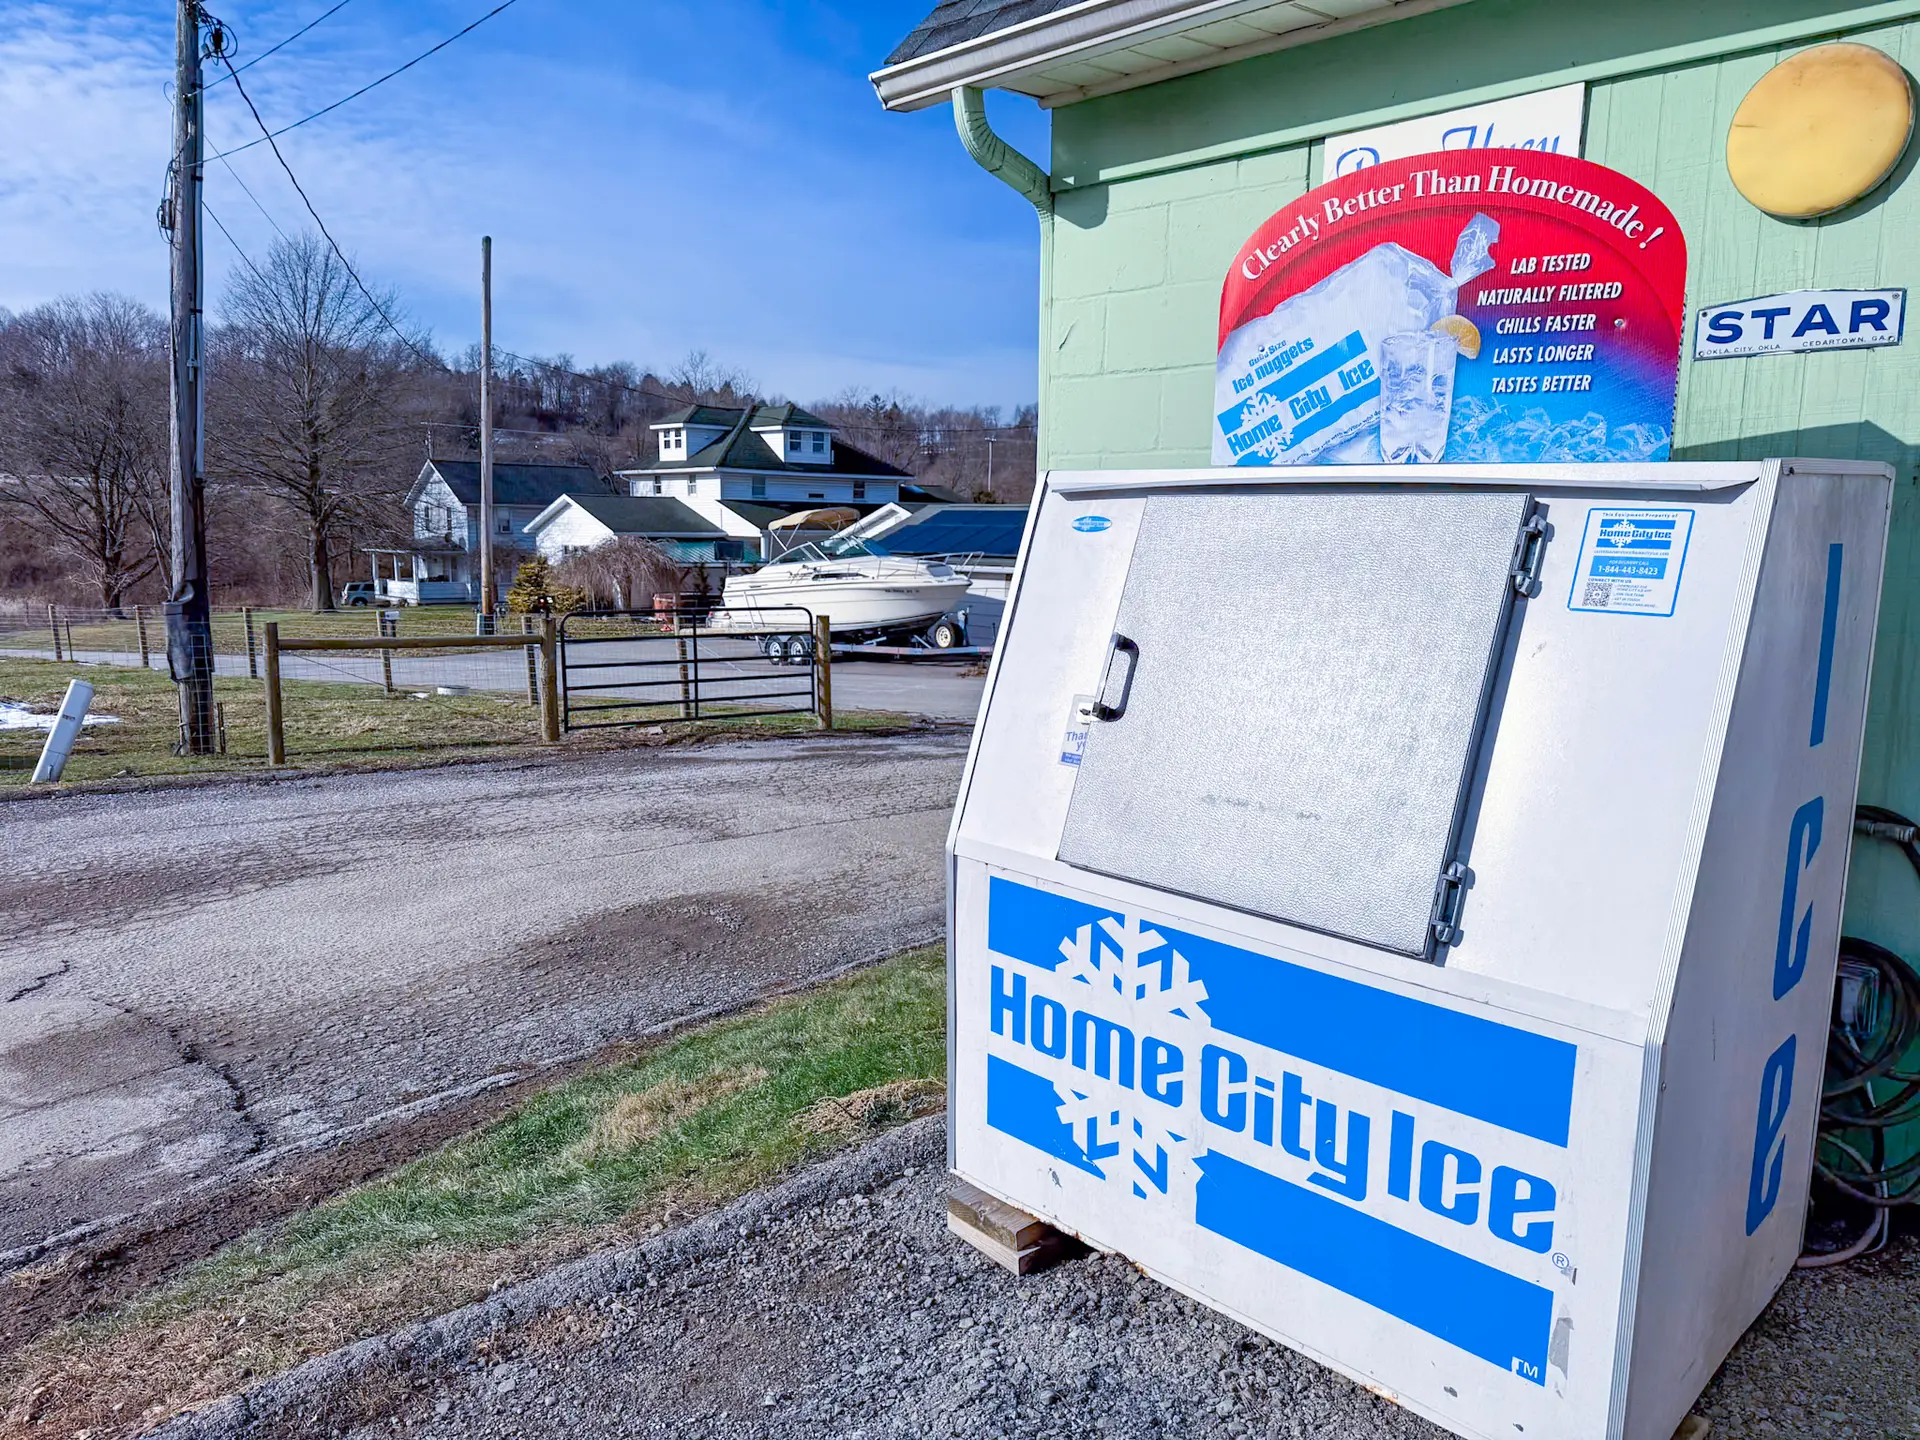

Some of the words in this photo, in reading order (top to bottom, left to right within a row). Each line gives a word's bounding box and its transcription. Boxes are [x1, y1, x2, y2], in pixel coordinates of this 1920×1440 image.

[1241, 212, 1320, 280] Clearly
[1322, 183, 1405, 225] Better
[1410, 169, 1480, 199] Than
[1510, 256, 1538, 275] LAB
[1541, 253, 1591, 273] TESTED
[1477, 285, 1556, 306] NATURALLY
[1558, 281, 1623, 302] FILTERED
[1496, 316, 1542, 335] CHILLS
[1545, 314, 1597, 332] FASTER
[1706, 299, 1891, 344] STAR
[1231, 373, 1255, 394] Ice
[1254, 337, 1314, 381] nuggets
[1493, 346, 1533, 365] LASTS
[1537, 344, 1595, 363] LONGER
[1491, 376, 1538, 394] TASTES
[1541, 374, 1592, 392] BETTER
[1226, 414, 1283, 457] Home
[1288, 385, 1333, 421] City
[1338, 359, 1375, 391] Ice
[1599, 529, 1631, 537] Home
[1631, 530, 1653, 540] City
[1654, 530, 1672, 539] Ice
[1598, 565, 1658, 575] 1-844-443-8423
[989, 963, 1185, 1109] Home
[1200, 1043, 1371, 1203] City
[1387, 1109, 1557, 1254] Ice
